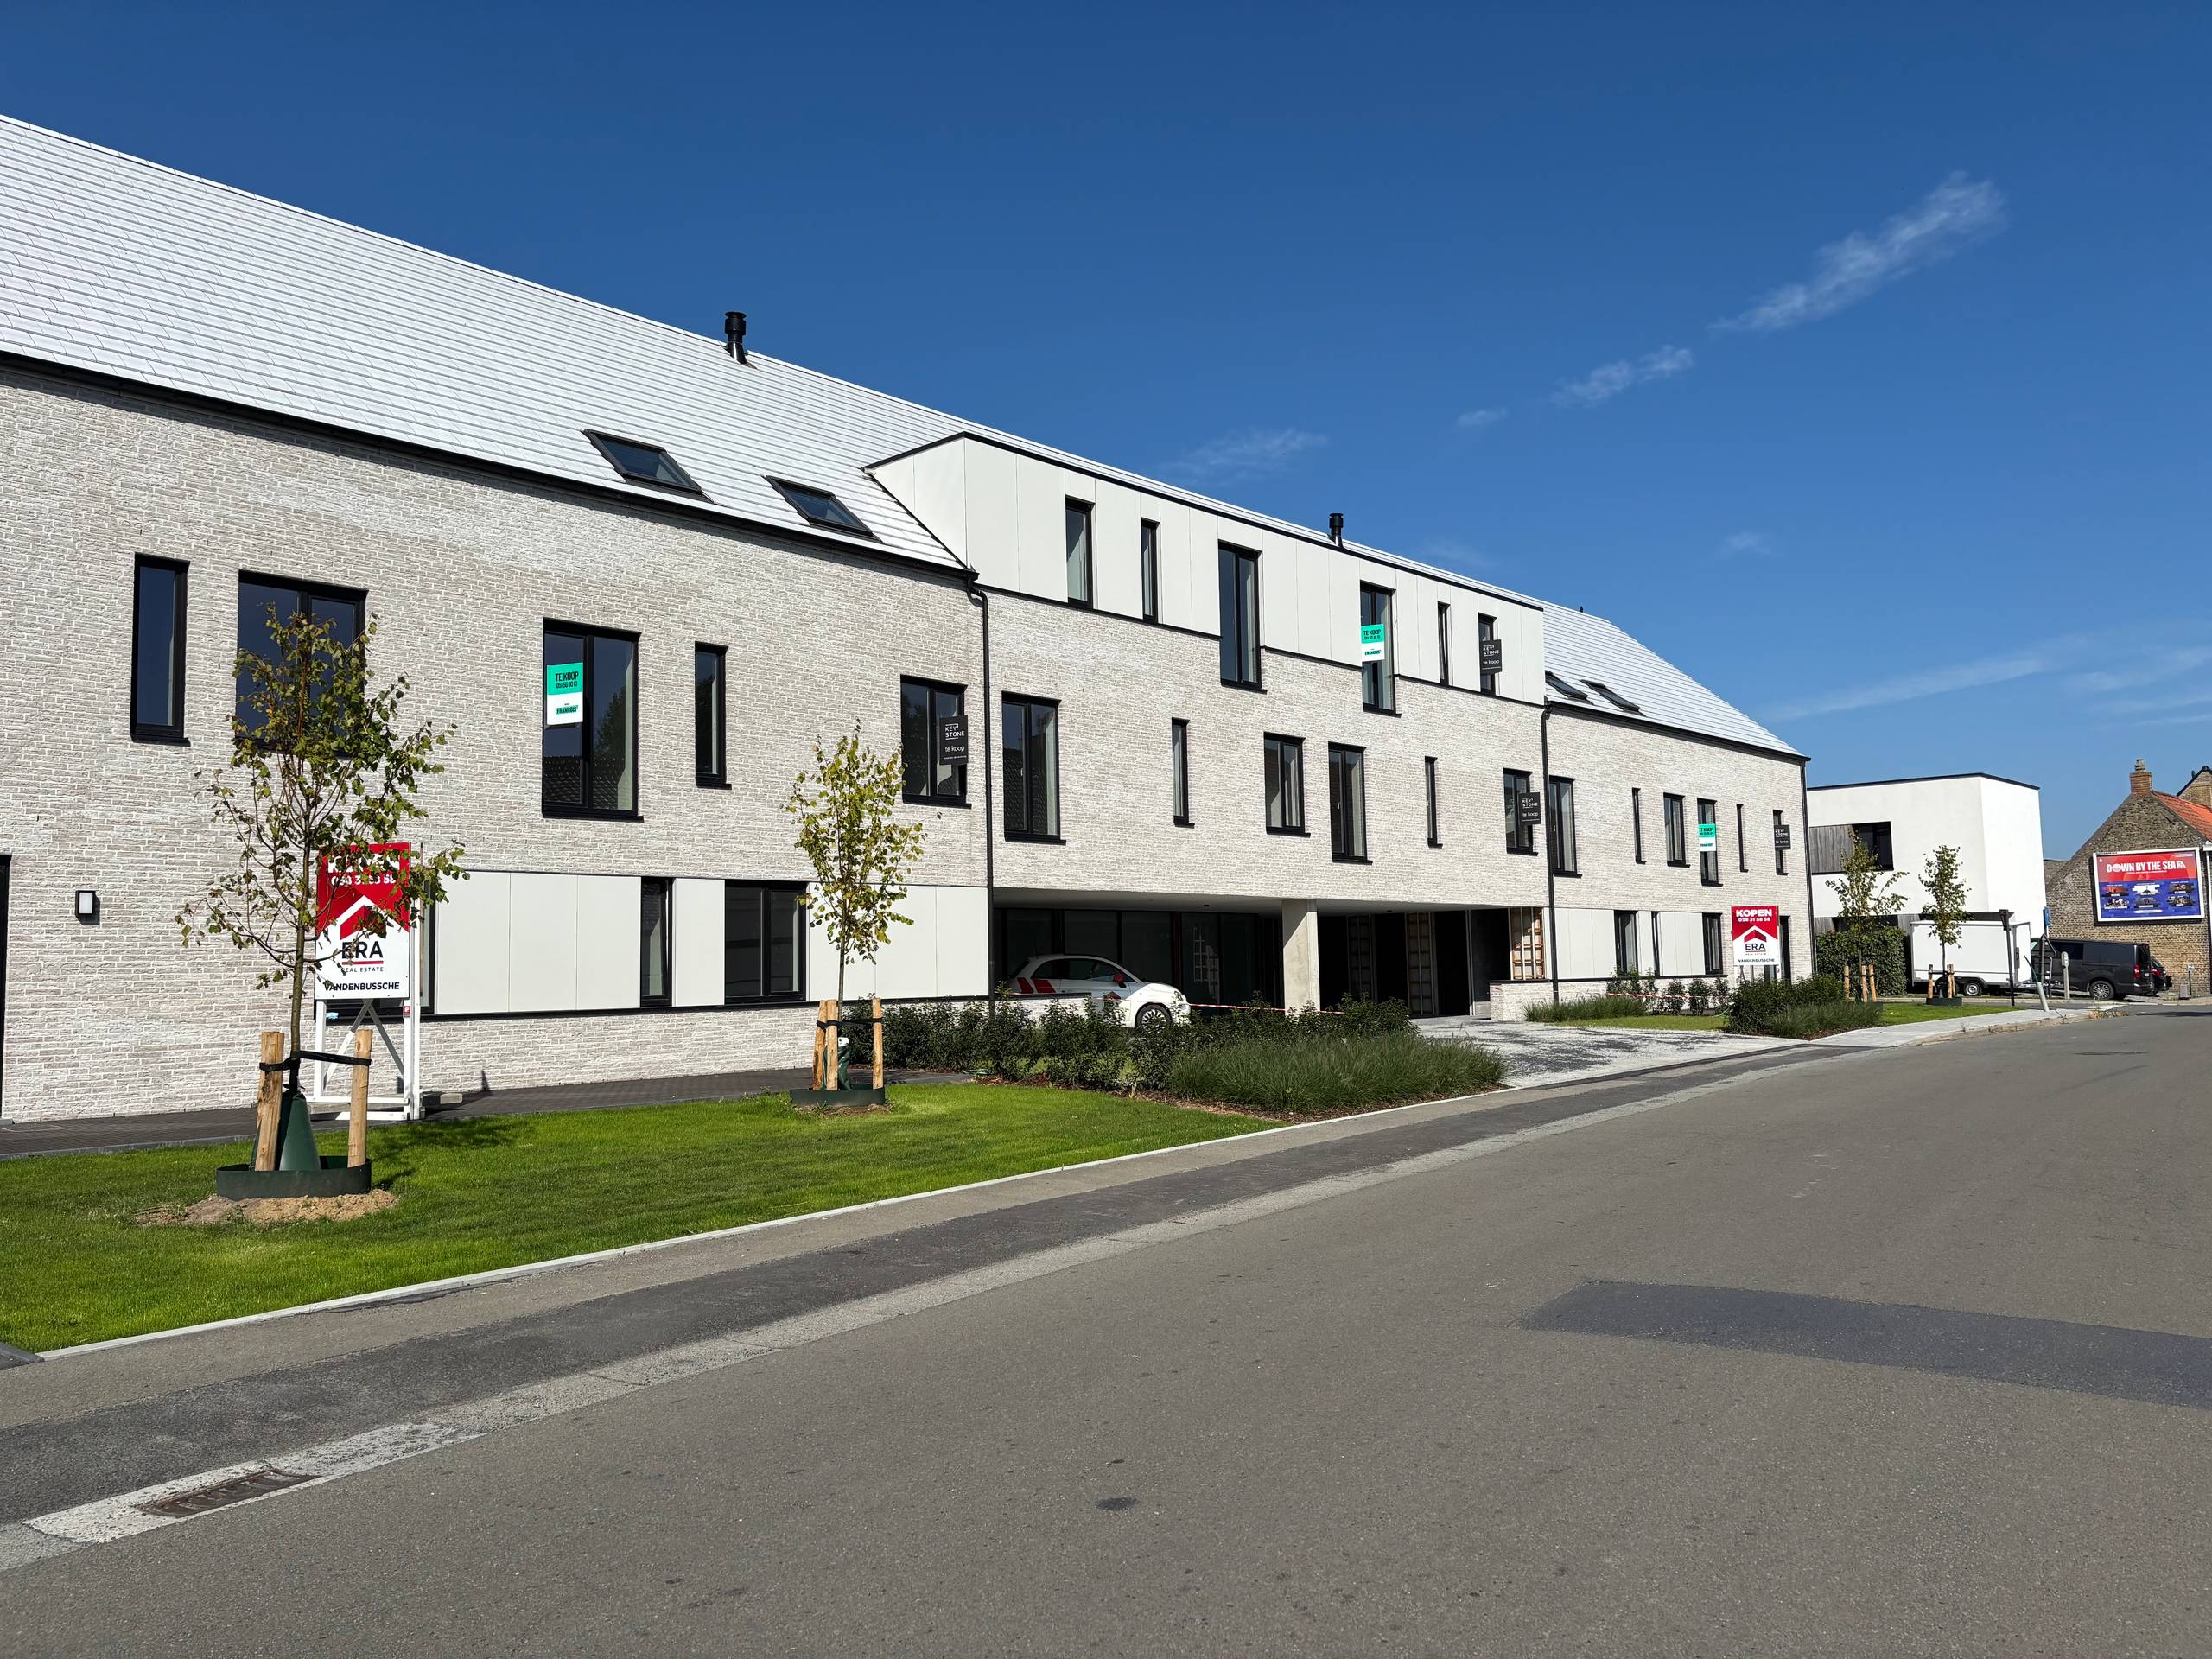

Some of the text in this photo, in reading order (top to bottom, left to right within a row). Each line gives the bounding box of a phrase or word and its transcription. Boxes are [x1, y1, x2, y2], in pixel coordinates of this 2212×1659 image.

[555, 671, 579, 682] TE KOOP
[2107, 861, 2135, 873] DOWN
[2135, 861, 2146, 871] BY
[2147, 861, 2160, 870] THE
[2162, 860, 2177, 869] SEA
[1736, 909, 1772, 918] KOPEN
[341, 940, 384, 959] ERA
[324, 982, 400, 991] VANDENBUSSCHE
